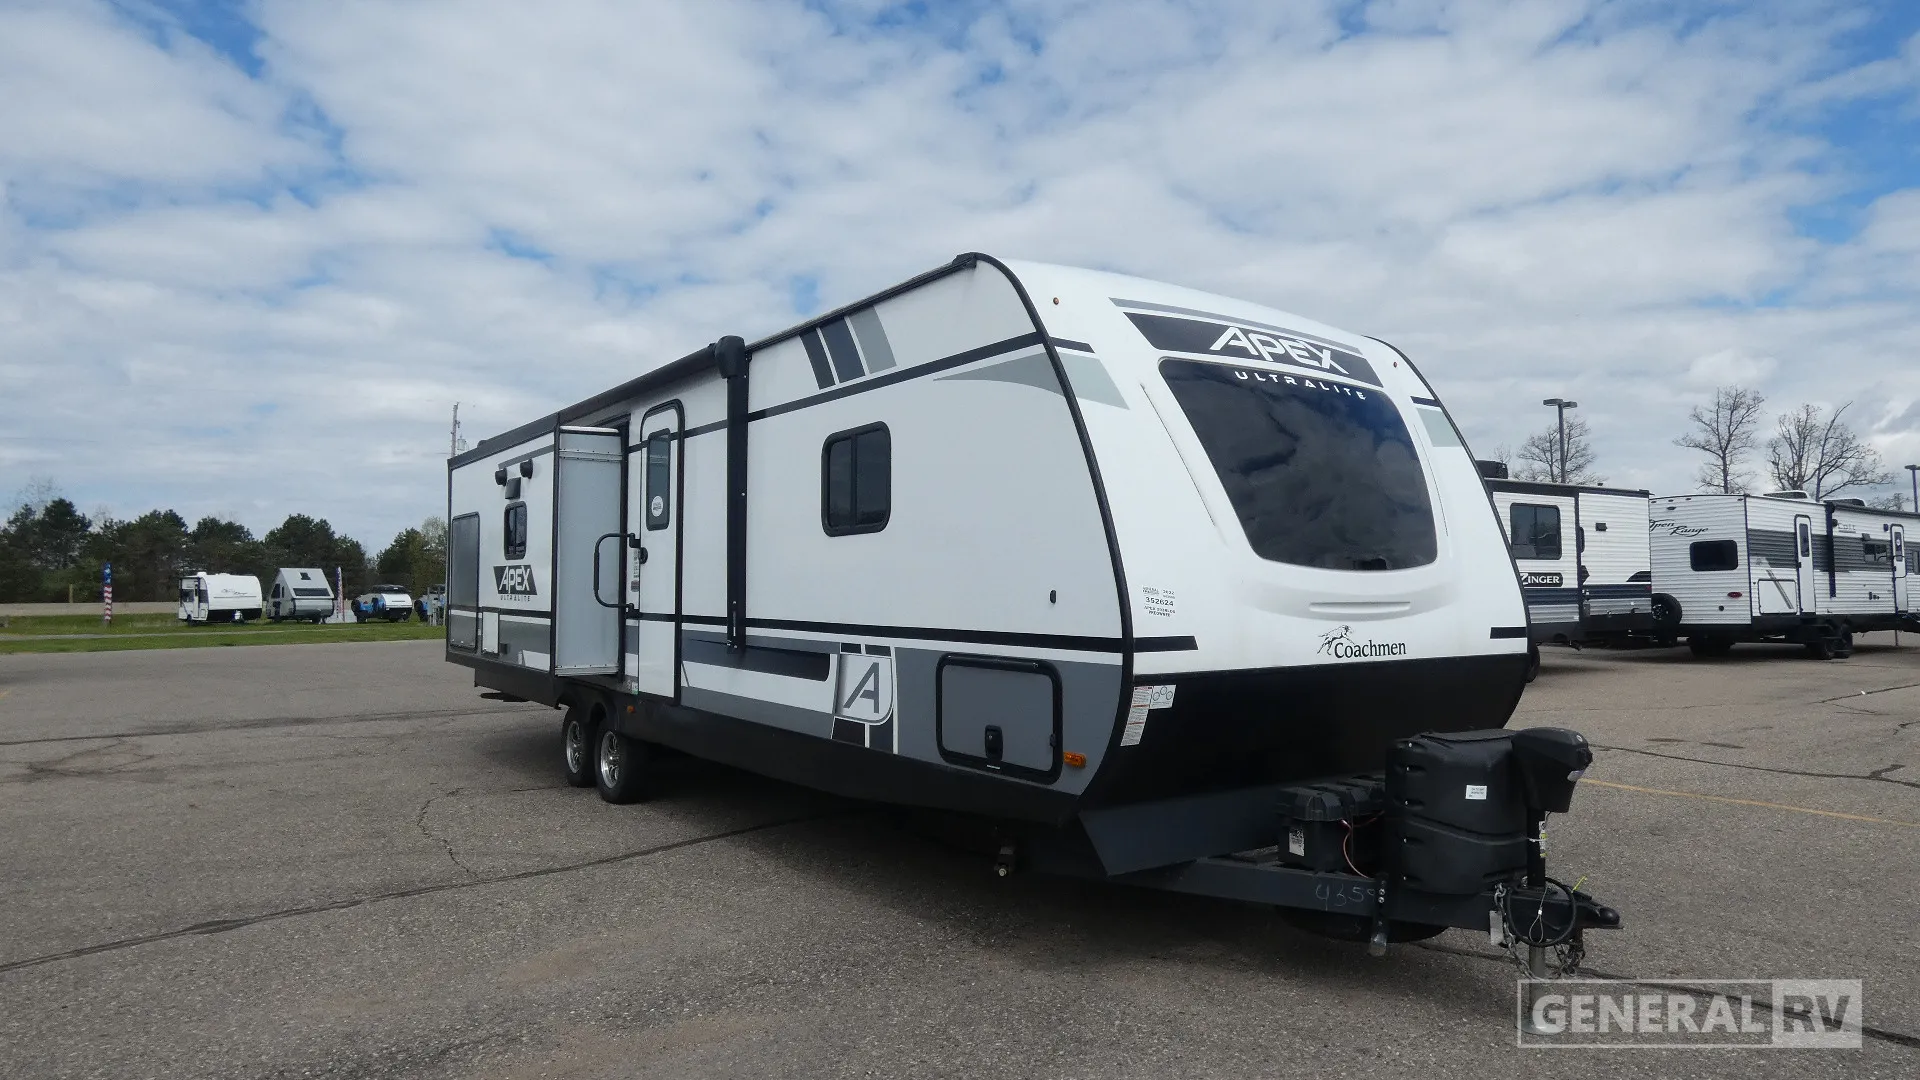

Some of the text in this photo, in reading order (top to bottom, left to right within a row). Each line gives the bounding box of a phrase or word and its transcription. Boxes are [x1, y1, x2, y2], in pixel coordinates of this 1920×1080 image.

[1209, 326, 1350, 375] APEX
[1234, 370, 1366, 400] ULTRALITE
[498, 565, 531, 594] APEX
[1520, 572, 1560, 585] ZINGER
[1334, 639, 1407, 659] Coachmen
